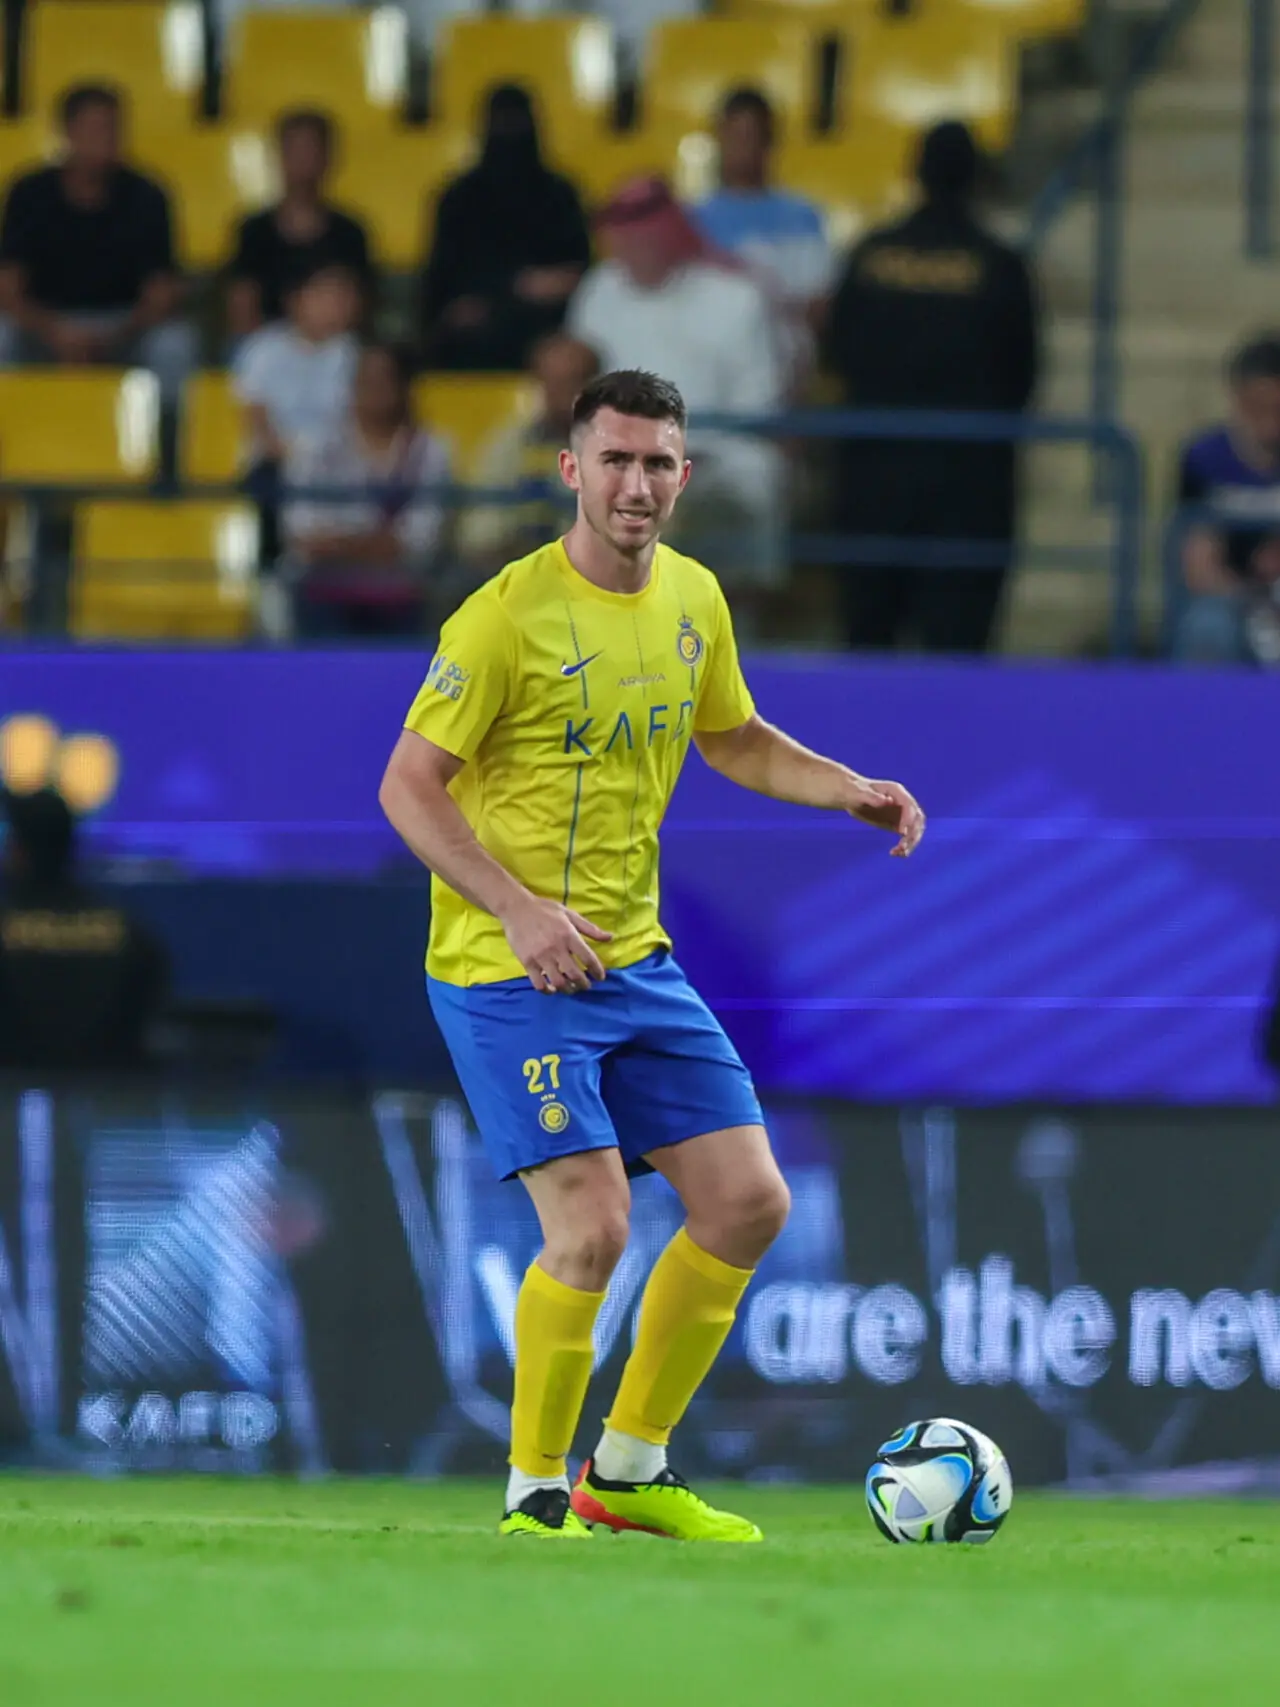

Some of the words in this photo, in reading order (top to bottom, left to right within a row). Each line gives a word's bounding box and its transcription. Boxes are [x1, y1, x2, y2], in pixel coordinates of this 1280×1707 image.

[522, 1053, 561, 1094] 27
[744, 1281, 926, 1386] are
[940, 1254, 1117, 1387] the
